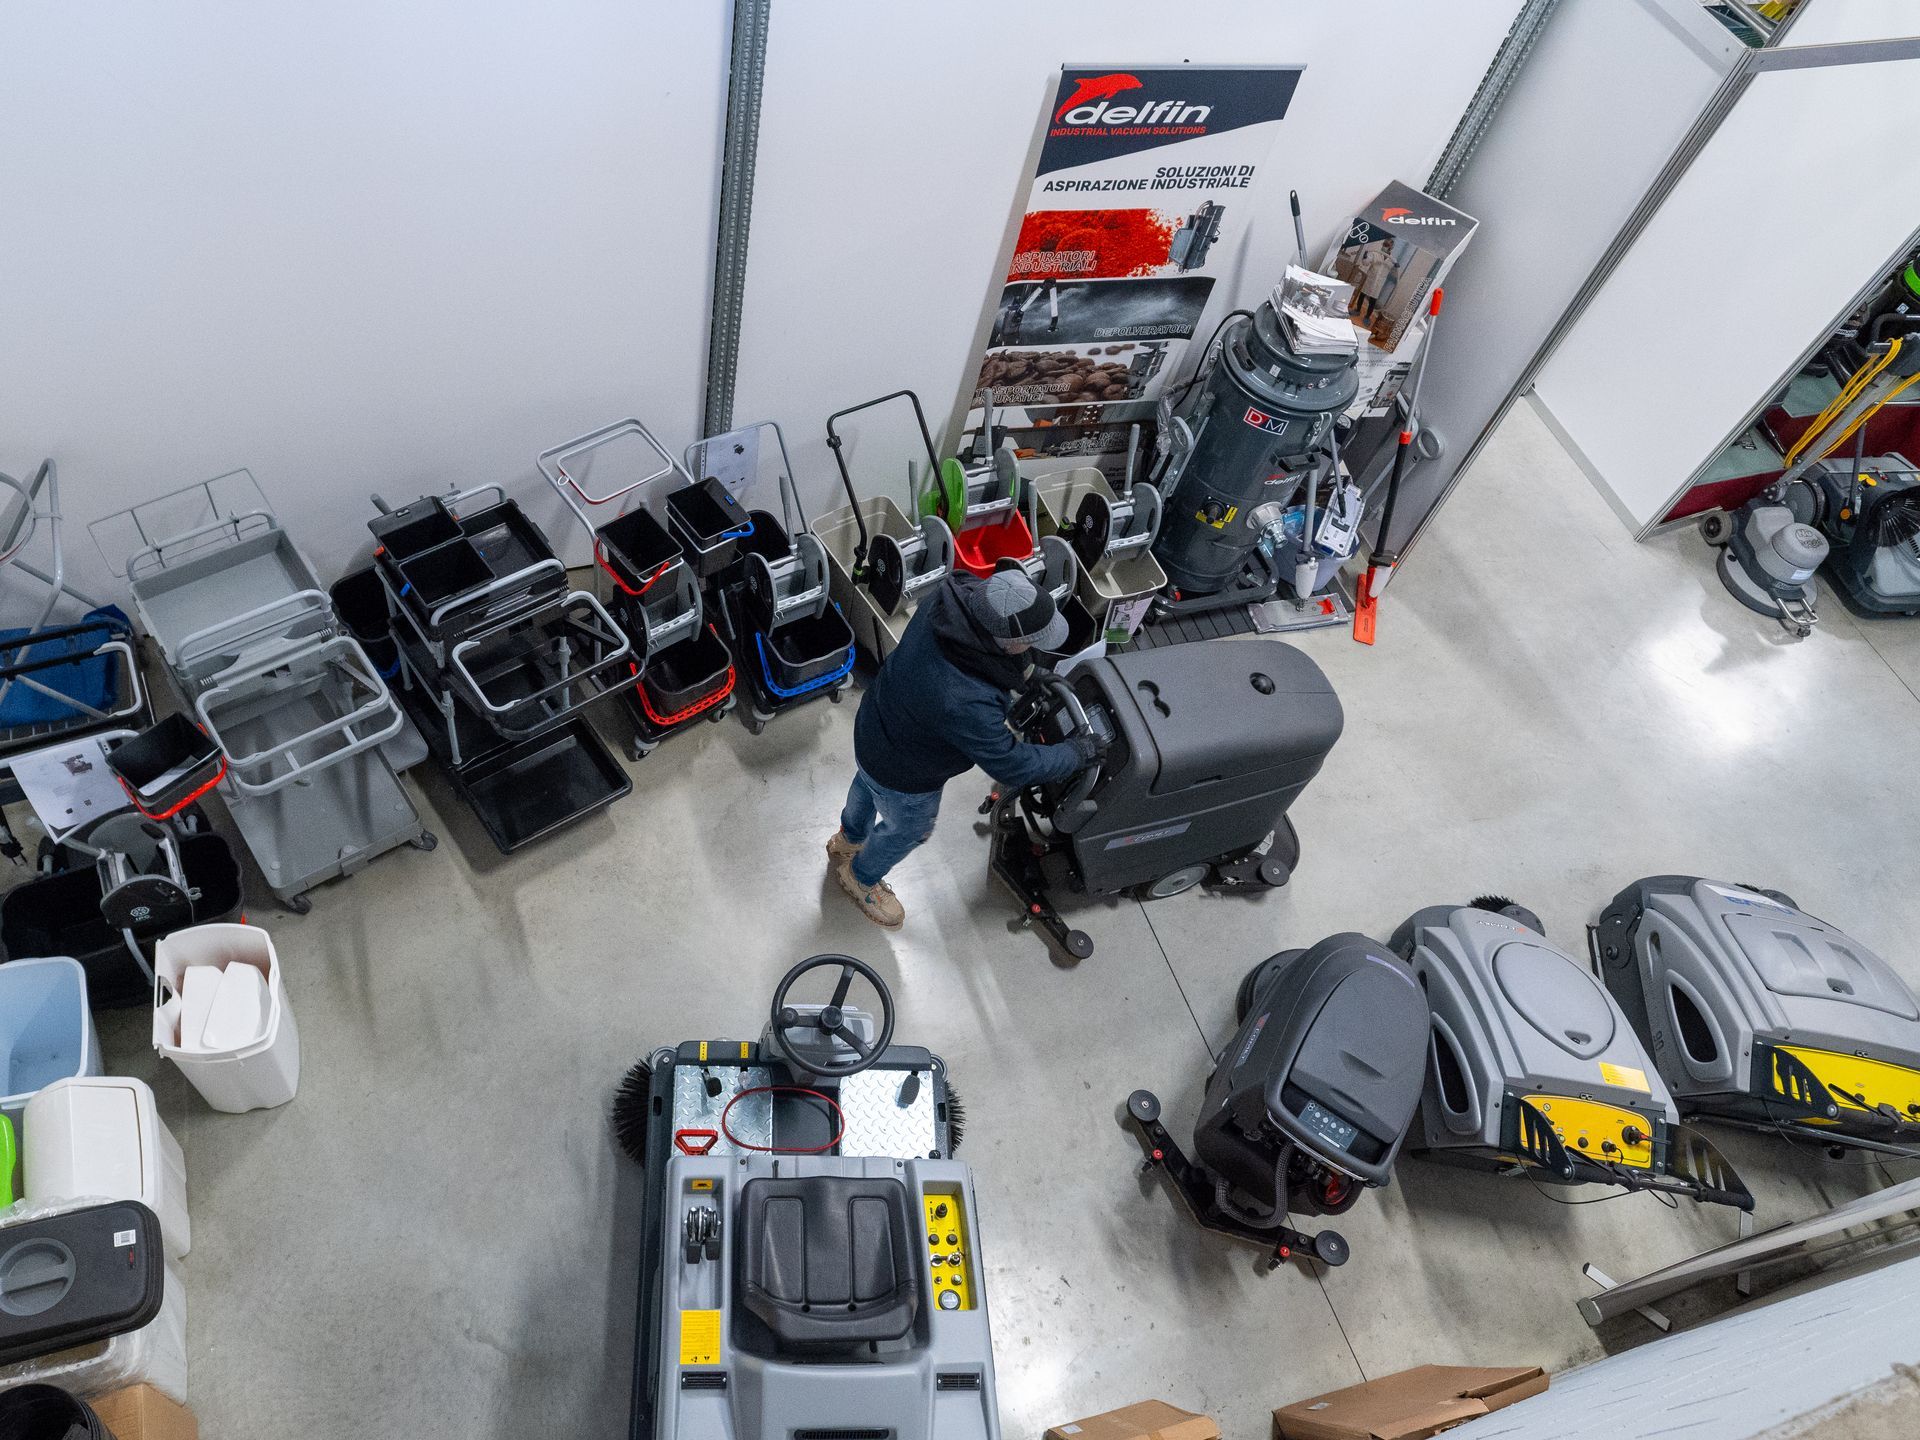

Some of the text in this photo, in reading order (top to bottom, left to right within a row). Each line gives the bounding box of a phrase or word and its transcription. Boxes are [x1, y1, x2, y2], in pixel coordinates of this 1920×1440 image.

[1064, 100, 1211, 125] delfin
[1050, 126, 1207, 137] INDUSTRIAL VACUUM SOLUTIONS
[1155, 165, 1256, 178] SOLUZIONI DI
[1043, 177, 1251, 192] ASPIRAZIONE INDUSTRIALE
[1387, 216, 1456, 226] delfin
[1015, 250, 1096, 263] ASPIRATORI
[1011, 260, 1097, 274] INDUSTRIALI
[1384, 277, 1432, 353] FARMACEUTICA
[1094, 323, 1191, 337] DEPOLVERATORI
